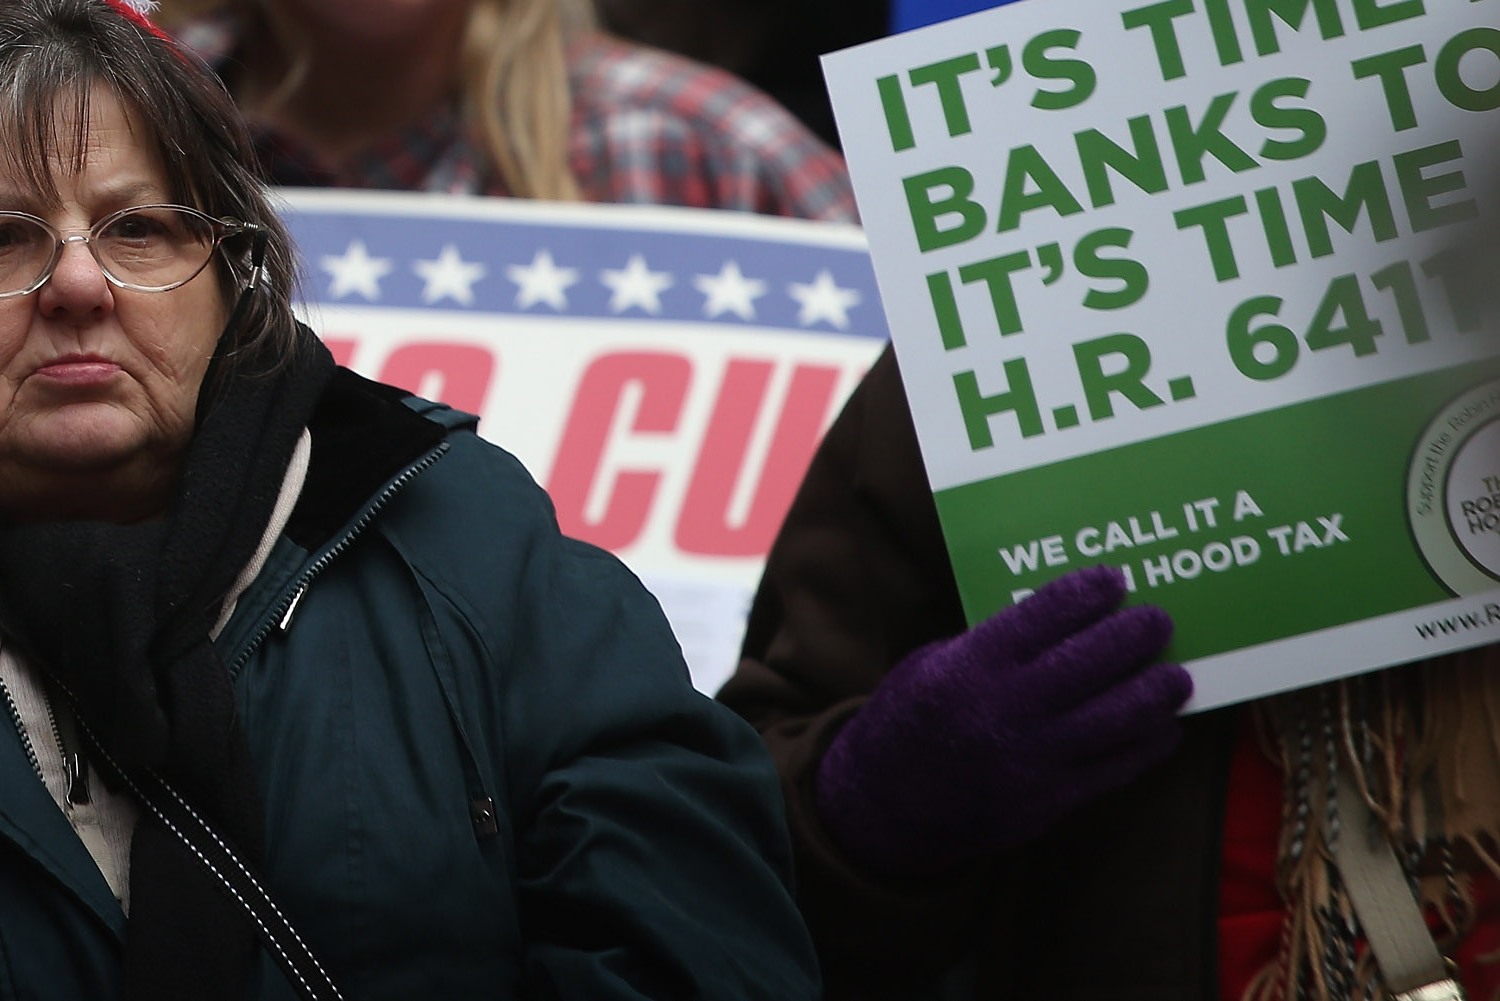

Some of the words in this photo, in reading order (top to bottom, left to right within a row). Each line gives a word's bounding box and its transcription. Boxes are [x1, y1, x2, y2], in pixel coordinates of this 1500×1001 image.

[875, 28, 1098, 153] IT'S
[902, 76, 1327, 254] BANKS
[1350, 27, 1500, 133] TO
[926, 227, 1149, 351] IT'S
[1173, 139, 1481, 283] TIME
[543, 349, 846, 559] CU
[952, 333, 1197, 452] H.R.
[999, 534, 1069, 576] WE
[1075, 510, 1179, 558] CALL
[1183, 497, 1220, 533] IT
[1233, 489, 1265, 521] A
[1142, 535, 1262, 588] HOOD
[1267, 512, 1351, 556] TAX
